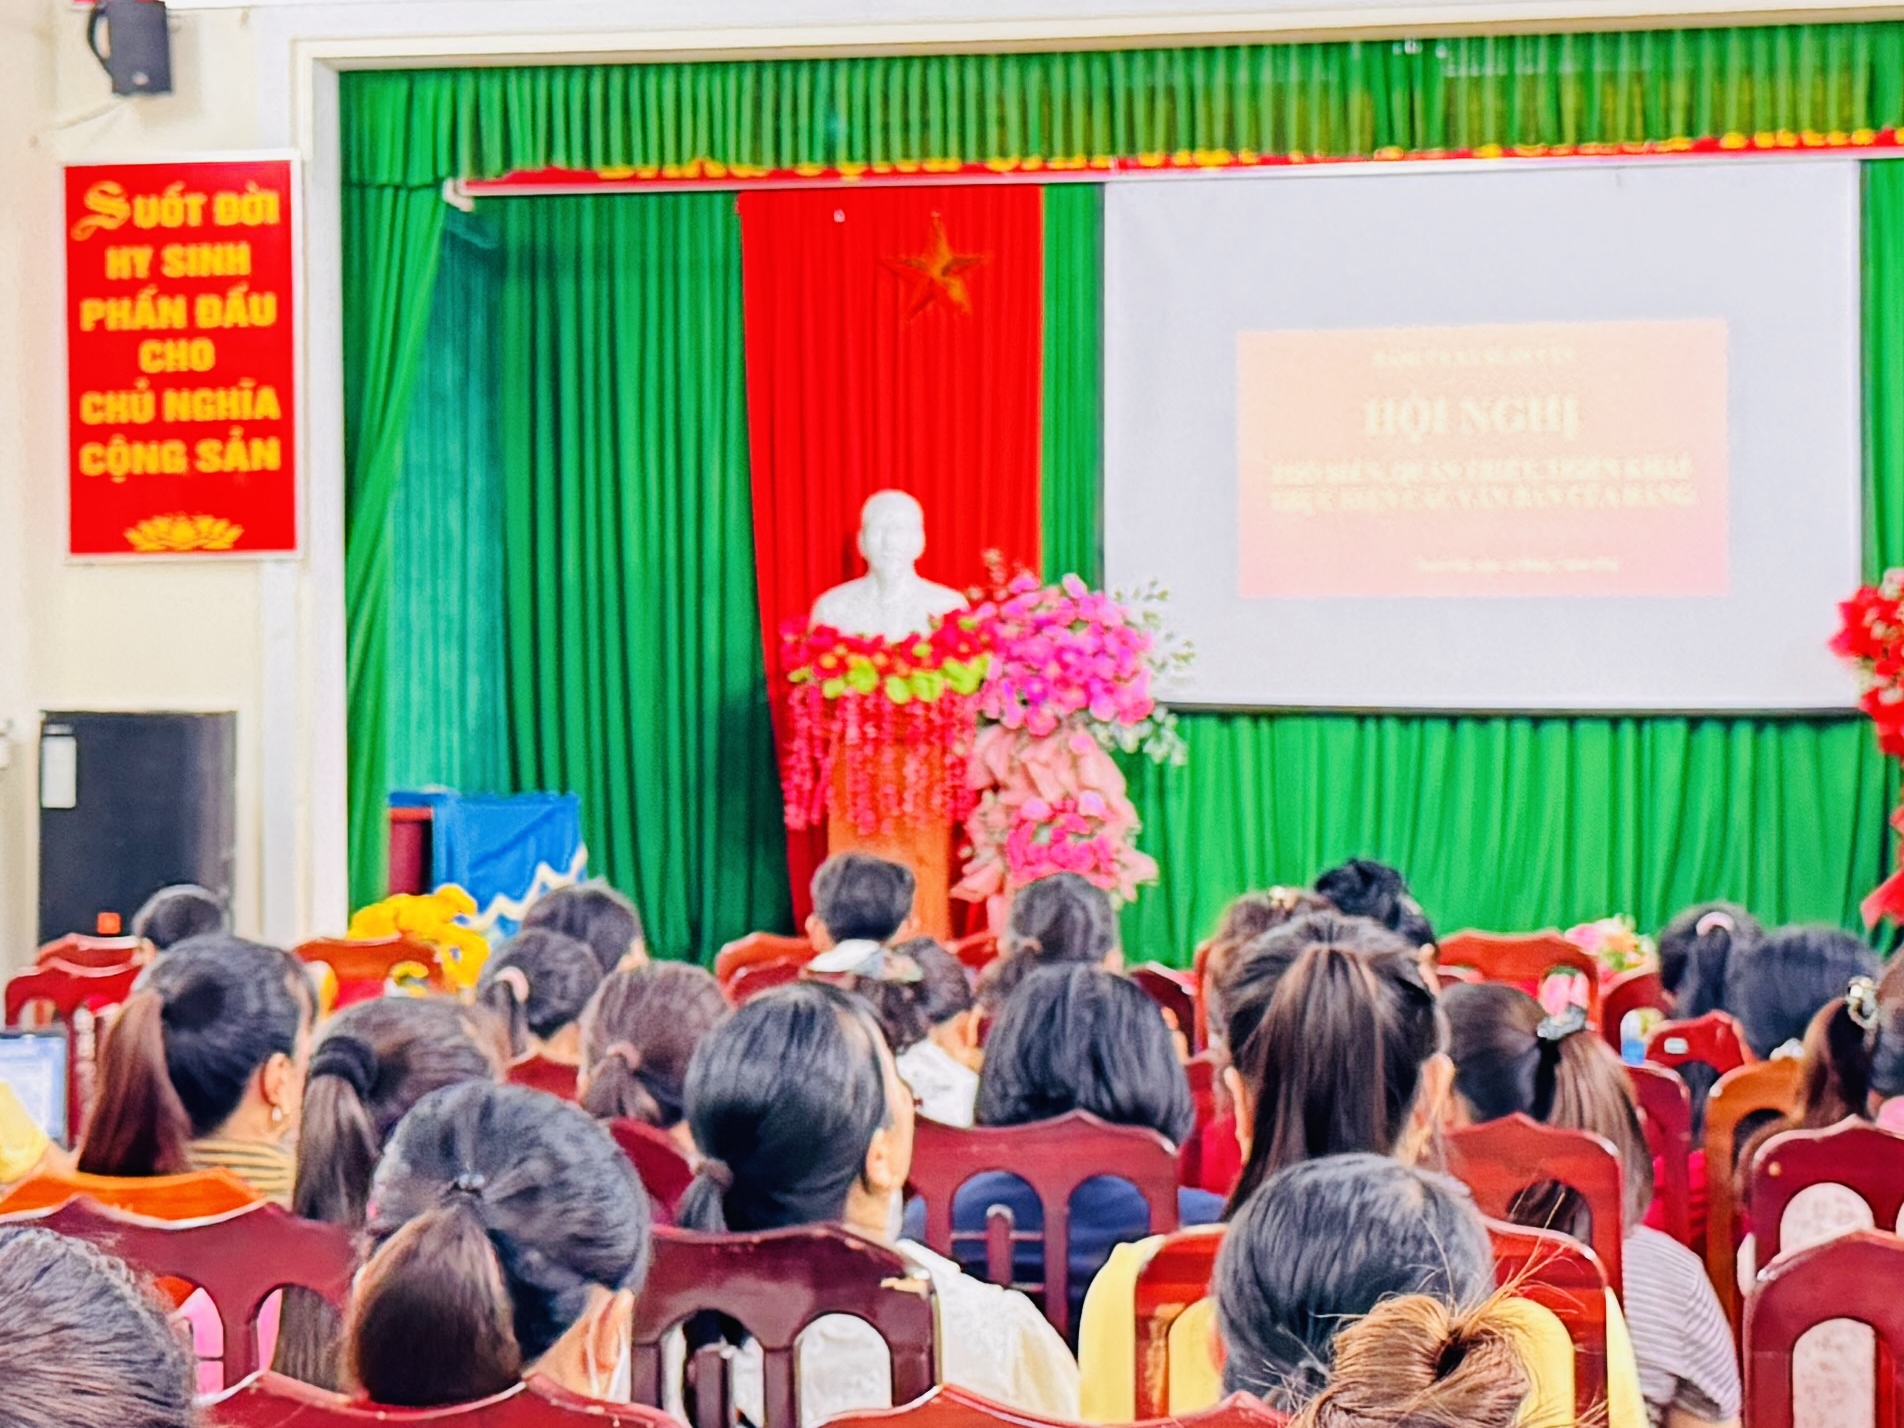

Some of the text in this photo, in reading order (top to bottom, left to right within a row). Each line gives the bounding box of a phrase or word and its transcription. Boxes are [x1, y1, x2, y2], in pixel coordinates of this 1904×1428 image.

[70, 180, 281, 242] SUỐT ĐỜI
[105, 241, 252, 280] HY SINH
[79, 281, 278, 332] PHẤN ĐẤU
[139, 337, 217, 375] CHO
[79, 376, 282, 426] CHỦ NGHĨA
[79, 425, 282, 484] CỘNG SẢN
